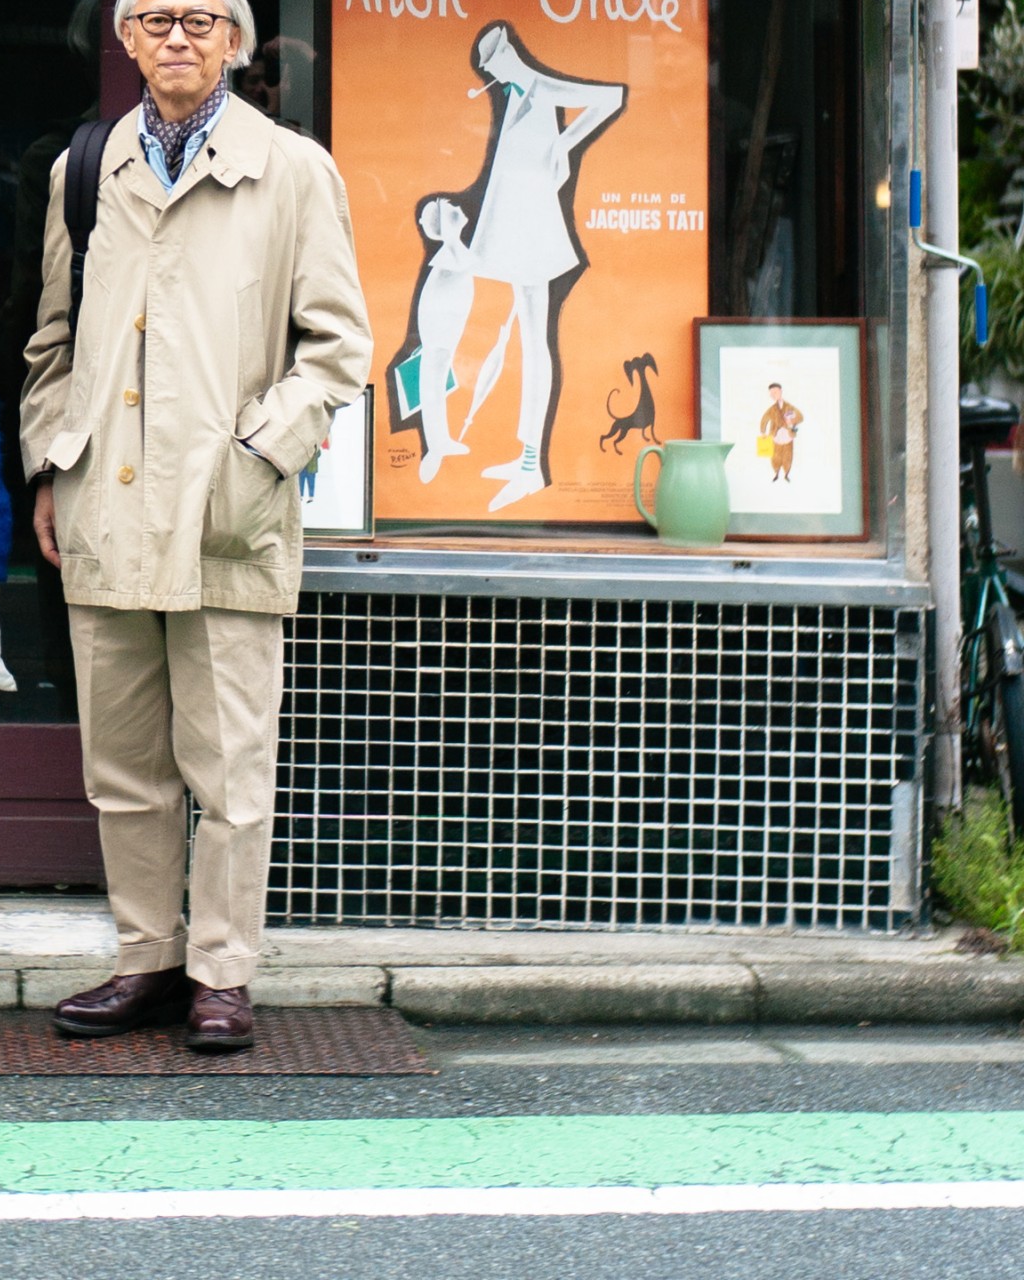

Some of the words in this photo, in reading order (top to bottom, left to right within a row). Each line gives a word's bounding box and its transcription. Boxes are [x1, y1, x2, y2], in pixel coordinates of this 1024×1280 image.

[601, 192, 622, 203] UN
[630, 192, 662, 204] FILM
[670, 193, 687, 204] DE
[584, 208, 662, 233] JACQUES
[667, 209, 705, 232] TATI
